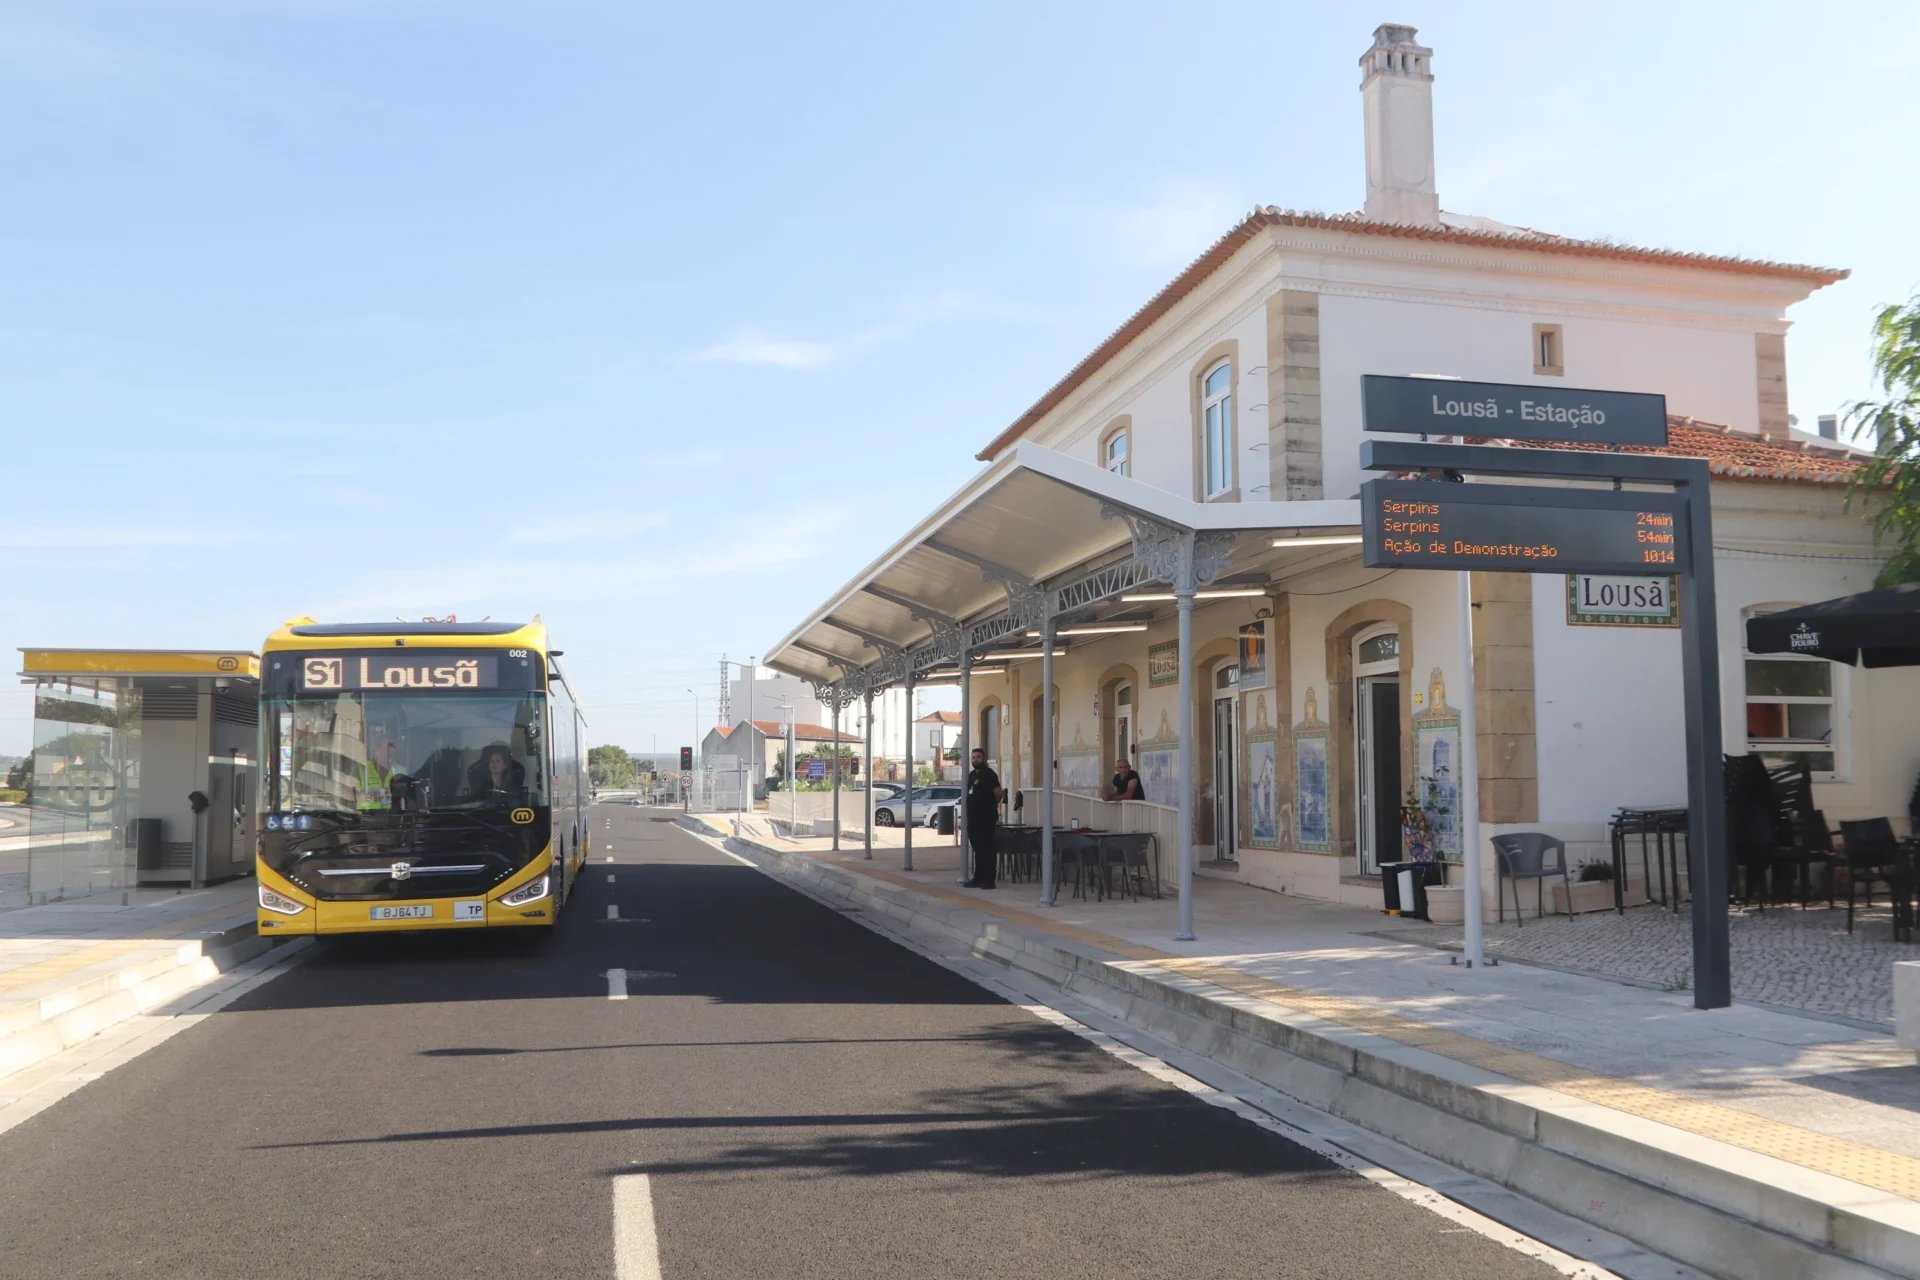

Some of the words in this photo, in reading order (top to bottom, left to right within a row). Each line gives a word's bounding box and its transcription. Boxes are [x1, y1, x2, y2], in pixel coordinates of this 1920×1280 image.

[1432, 395, 1498, 418] Lousã
[1520, 400, 1605, 428] Estação
[1384, 500, 1439, 516] Serpins
[1636, 512, 1673, 526] 24min
[1384, 518, 1440, 534] Serpins
[1637, 530, 1674, 544] 54min
[1384, 538, 1421, 555] Ação
[1429, 540, 1447, 554] de
[1454, 541, 1557, 559] Demonstração
[1583, 577, 1663, 608] Lousã
[509, 650, 527, 658] 002
[1791, 639, 1819, 647] D'OURO
[306, 659, 341, 686] S1
[360, 657, 478, 688] Lousã
[384, 907, 426, 918] BJ64TJ
[468, 905, 482, 915] TP
